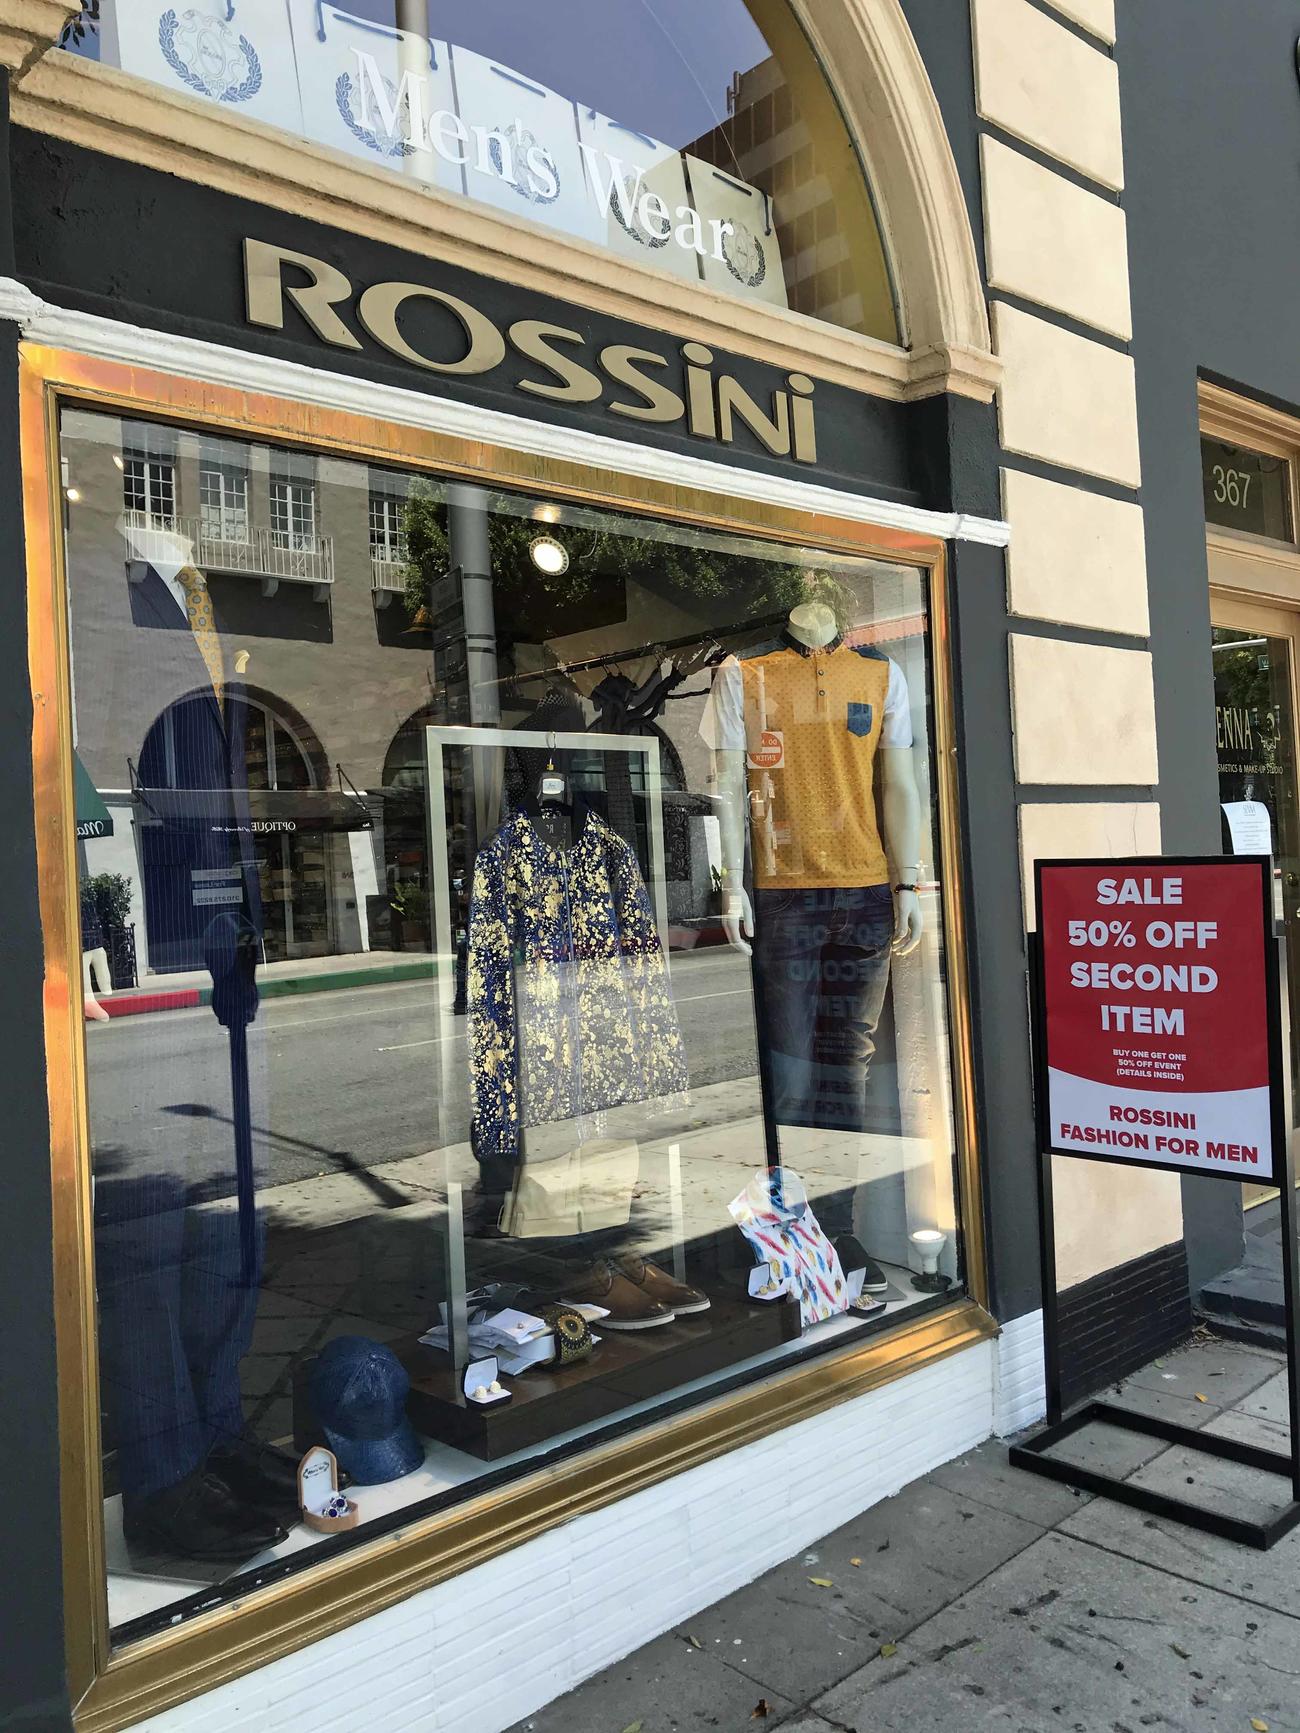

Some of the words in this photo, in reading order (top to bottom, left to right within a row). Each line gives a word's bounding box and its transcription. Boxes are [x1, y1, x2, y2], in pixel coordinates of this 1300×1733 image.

[348, 44, 557, 198] Men's
[577, 142, 735, 263] Wear
[1212, 464, 1251, 509] 367
[1096, 877, 1183, 905] SALE
[1068, 920, 1137, 948] 50%
[1145, 921, 1218, 949] OFF
[1070, 962, 1219, 993] SECOND
[1100, 1004, 1185, 1036] ITEM
[1112, 1048, 1130, 1057] BUY
[1131, 1050, 1149, 1058] ONE
[1150, 1052, 1167, 1060] GET
[1168, 1053, 1187, 1061] ONE
[1118, 1058, 1135, 1067] 50%
[1136, 1060, 1153, 1068] OFF
[1154, 1061, 1182, 1071] EVENT
[1116, 1067, 1152, 1078] (DETAILS
[1153, 1071, 1185, 1082] INSIDE)
[1109, 1105, 1196, 1130] ROSSINI
[1060, 1123, 1149, 1150] FASHION
[1155, 1136, 1199, 1157] FOR
[1206, 1141, 1258, 1164] MEN
